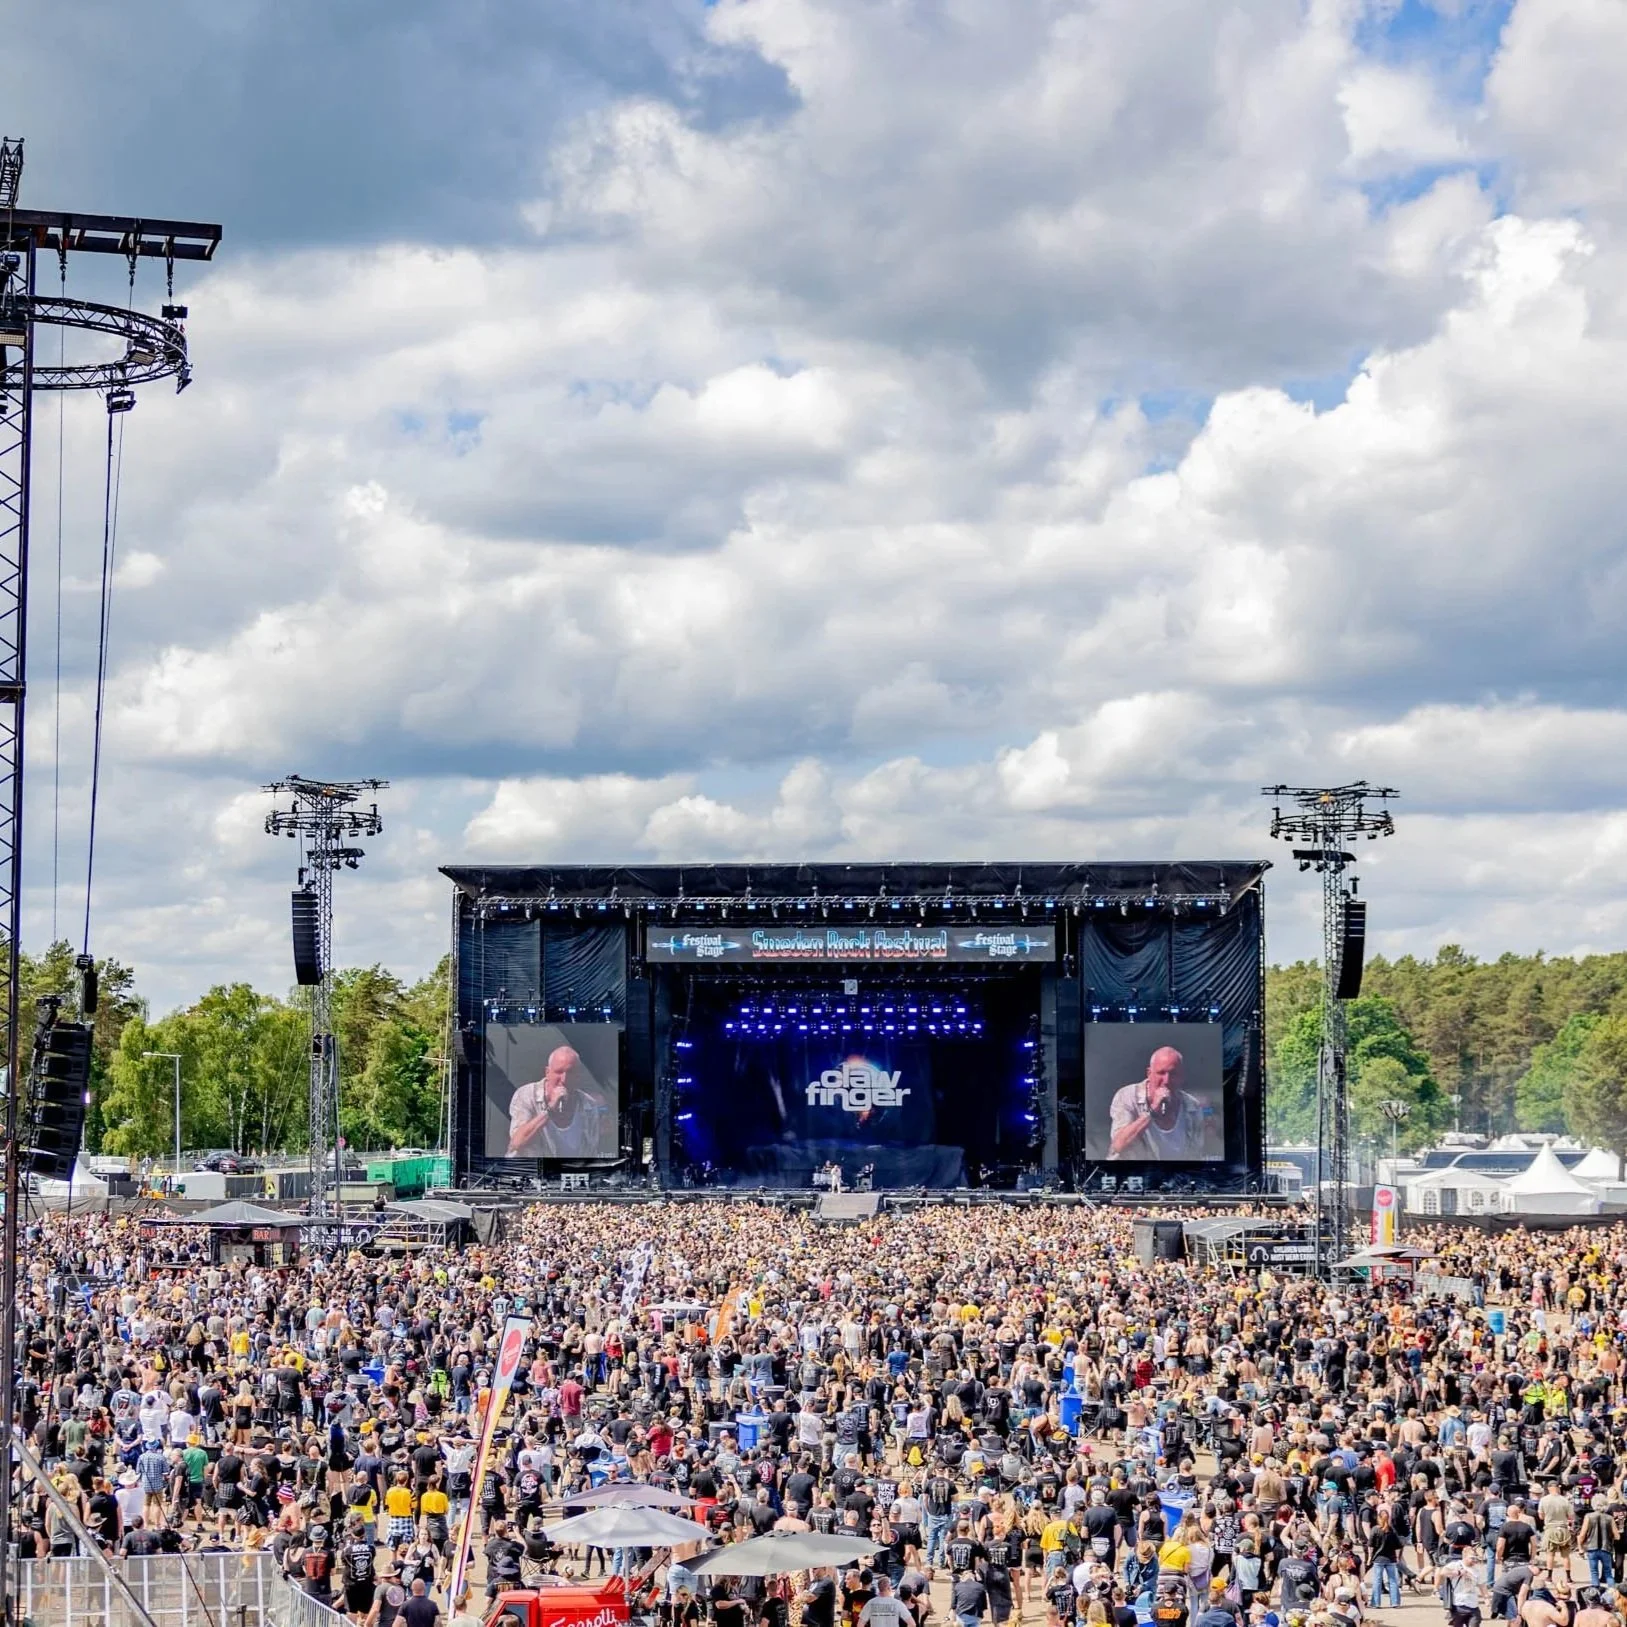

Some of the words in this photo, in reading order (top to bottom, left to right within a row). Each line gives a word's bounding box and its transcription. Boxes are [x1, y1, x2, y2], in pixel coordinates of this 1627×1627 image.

[682, 933, 722, 946] Festival
[752, 930, 824, 958] Sweden
[827, 930, 871, 958] Rock
[874, 930, 947, 958] Festival
[975, 933, 1015, 946] Festival
[696, 945, 725, 957] Stage
[989, 944, 1017, 957] Stage
[820, 1062, 902, 1088] claw
[805, 1081, 911, 1111] finger
[140, 1227, 156, 1237] BAR
[253, 1229, 270, 1240] BAR
